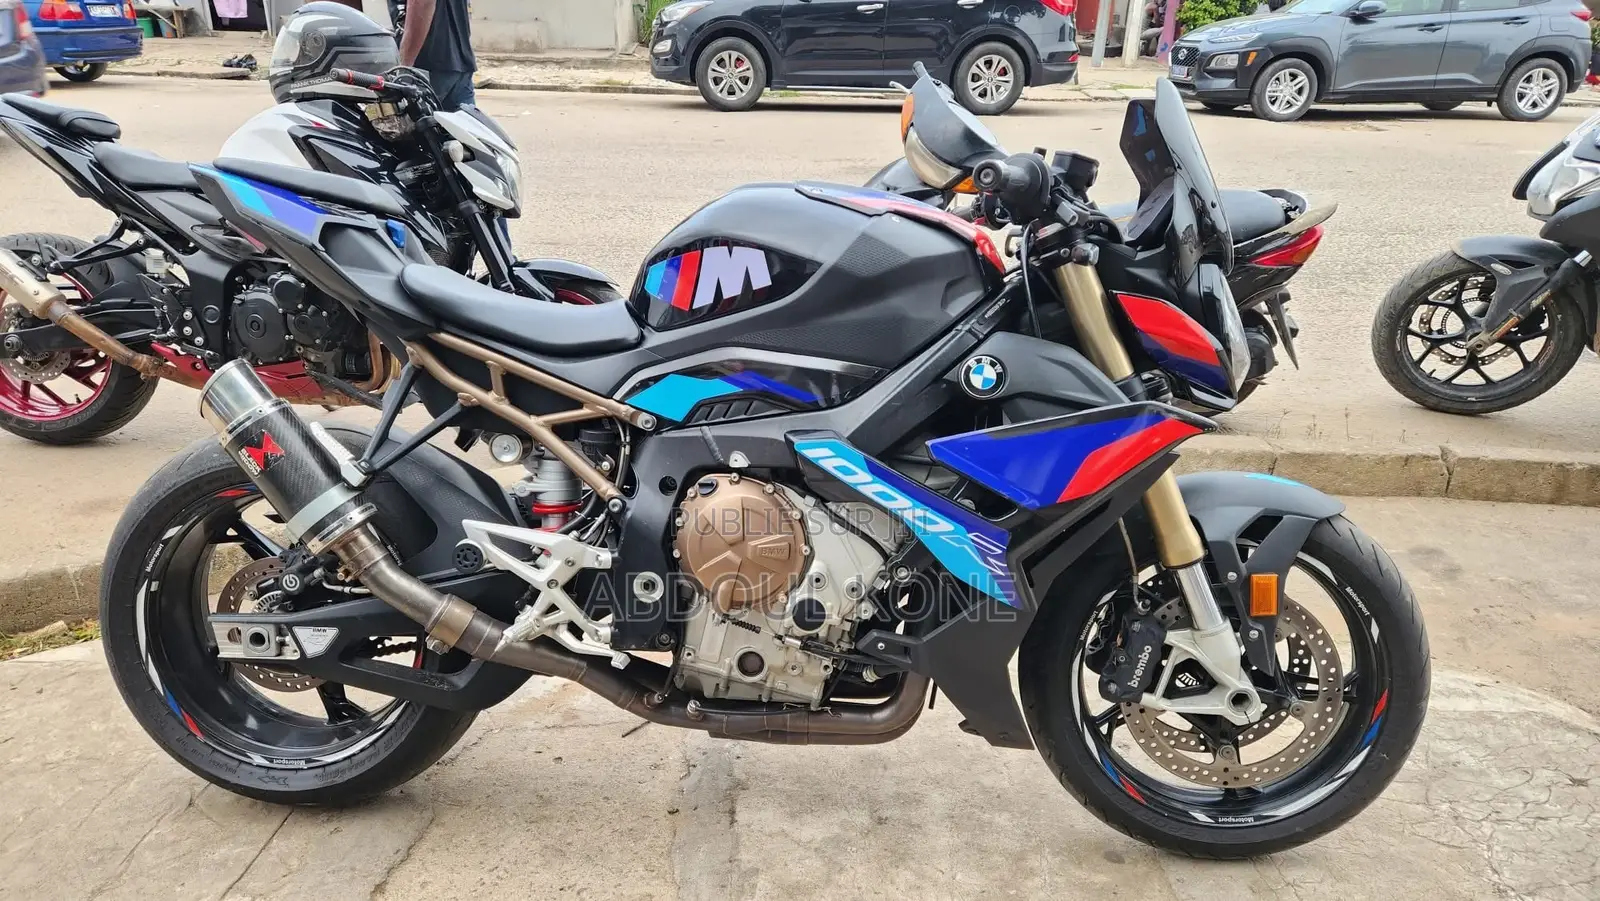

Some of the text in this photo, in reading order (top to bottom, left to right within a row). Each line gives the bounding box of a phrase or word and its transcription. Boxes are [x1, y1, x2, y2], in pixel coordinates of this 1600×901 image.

[692, 245, 772, 309] M
[968, 357, 1004, 373] BMW
[240, 448, 262, 473] BLACK
[144, 543, 165, 573] Motorsport
[761, 547, 785, 557] BMW
[1344, 586, 1371, 617] Motorsport
[1079, 609, 1099, 641] Motorsport
[1127, 645, 1153, 689] brembo
[273, 758, 306, 767] Motorsport
[1218, 815, 1255, 824] Motorsport
